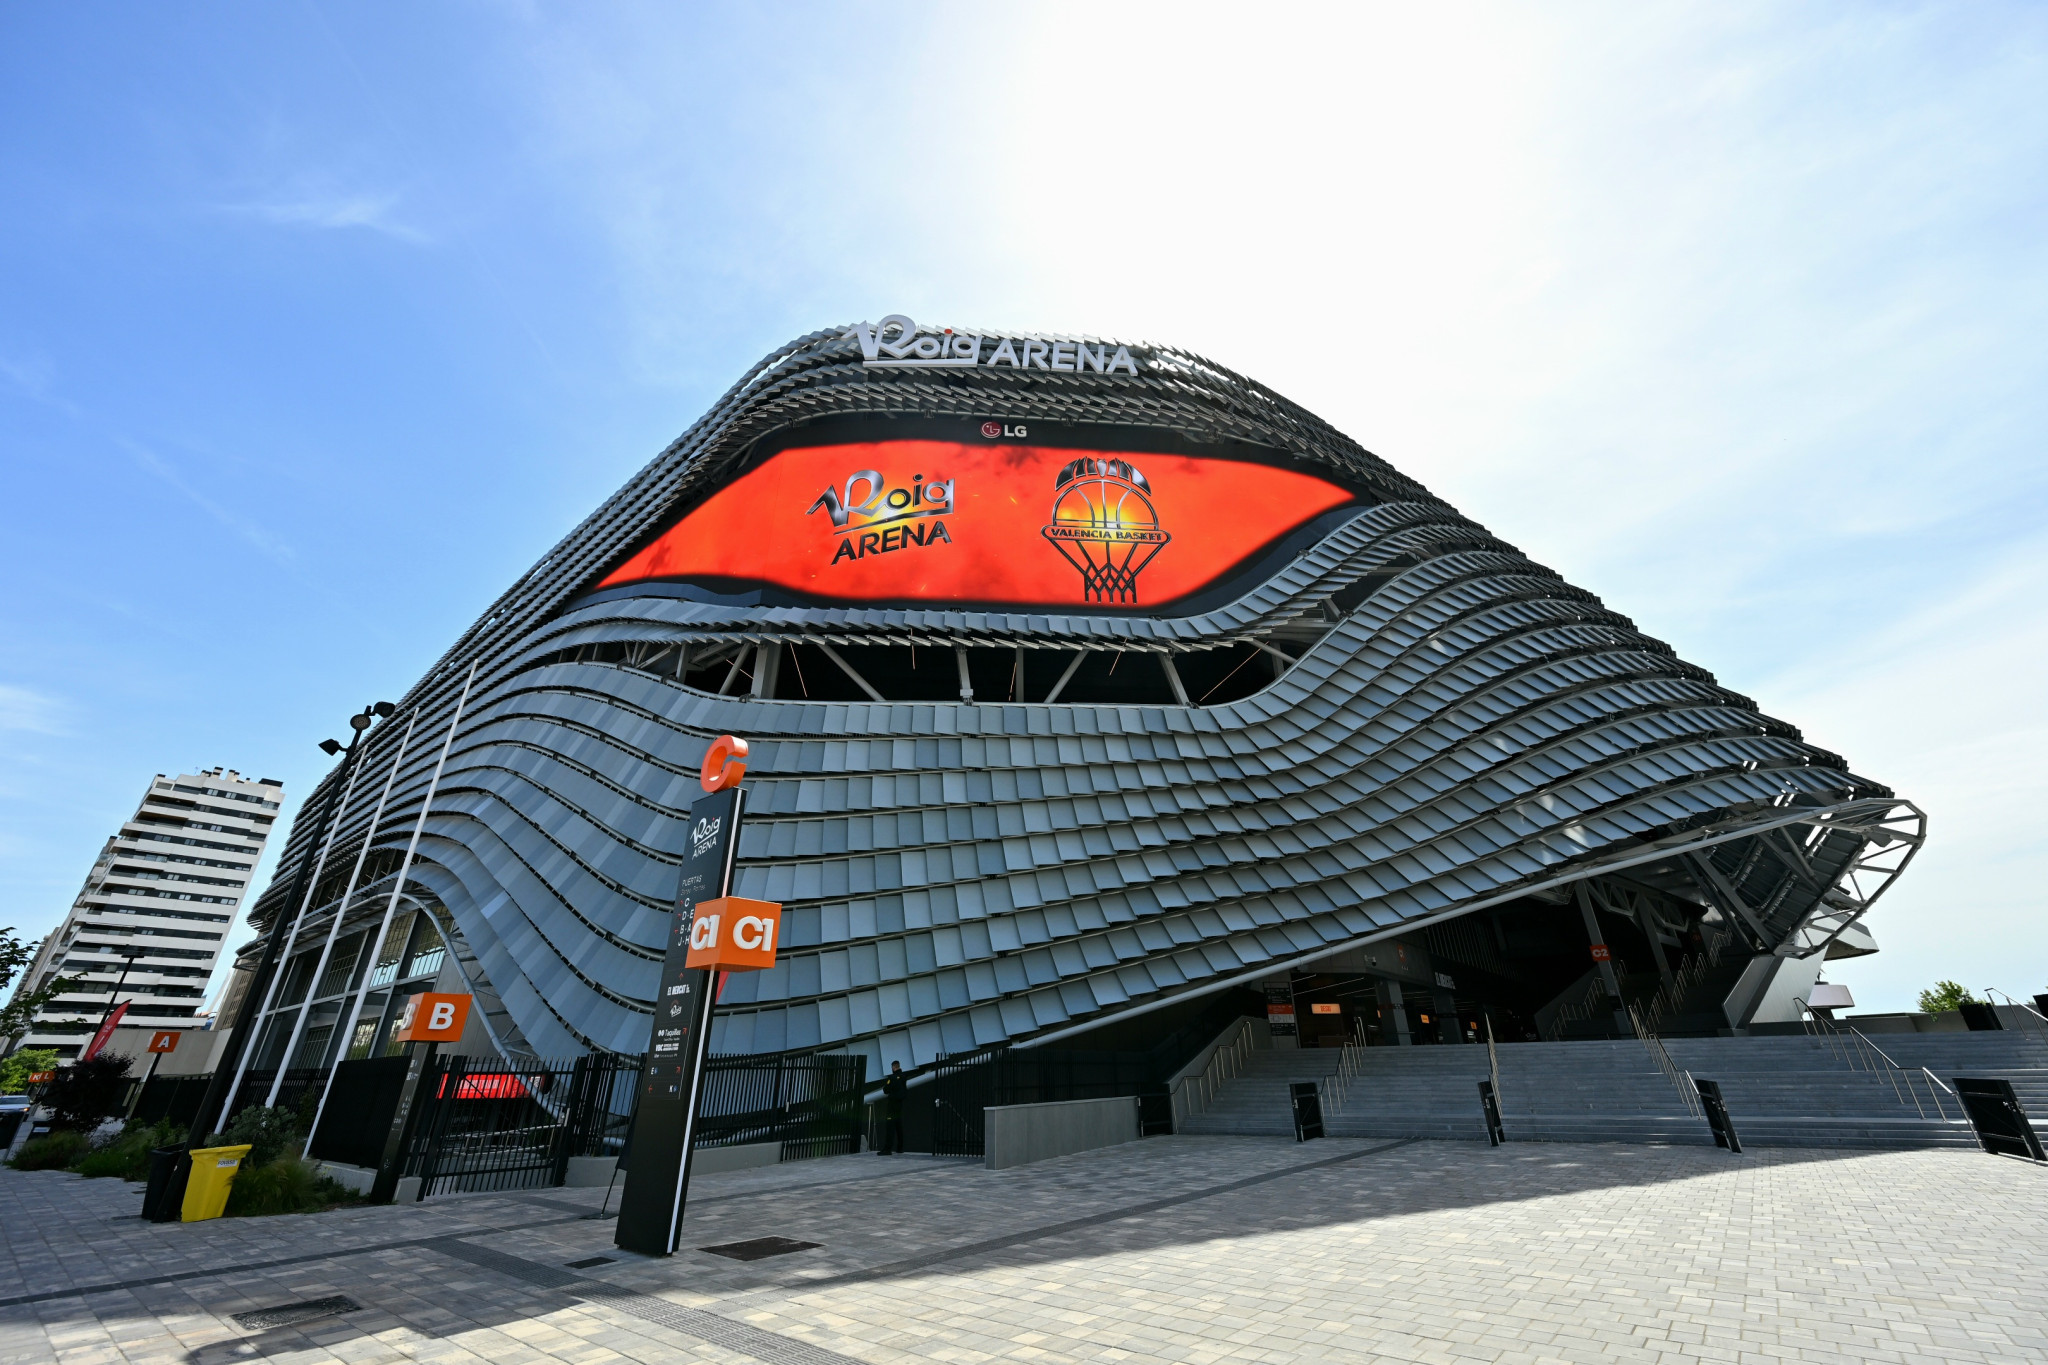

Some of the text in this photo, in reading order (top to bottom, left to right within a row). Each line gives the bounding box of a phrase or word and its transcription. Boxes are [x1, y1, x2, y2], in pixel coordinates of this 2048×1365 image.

[841, 314, 1138, 376] Roig ARENA
[1004, 424, 1027, 438] LG
[805, 470, 955, 535] Roig
[831, 520, 952, 566] ARENA
[1050, 528, 1163, 541] VALENCIA BASKET
[690, 816, 721, 848] Roig
[692, 836, 717, 860] ARENA
[682, 875, 703, 887] PUERTAS
[684, 897, 690, 907] C
[691, 914, 720, 950] C1
[732, 915, 774, 951] C1
[1592, 948, 1608, 958] C2
[427, 1002, 456, 1030] B
[157, 1035, 170, 1048] A
